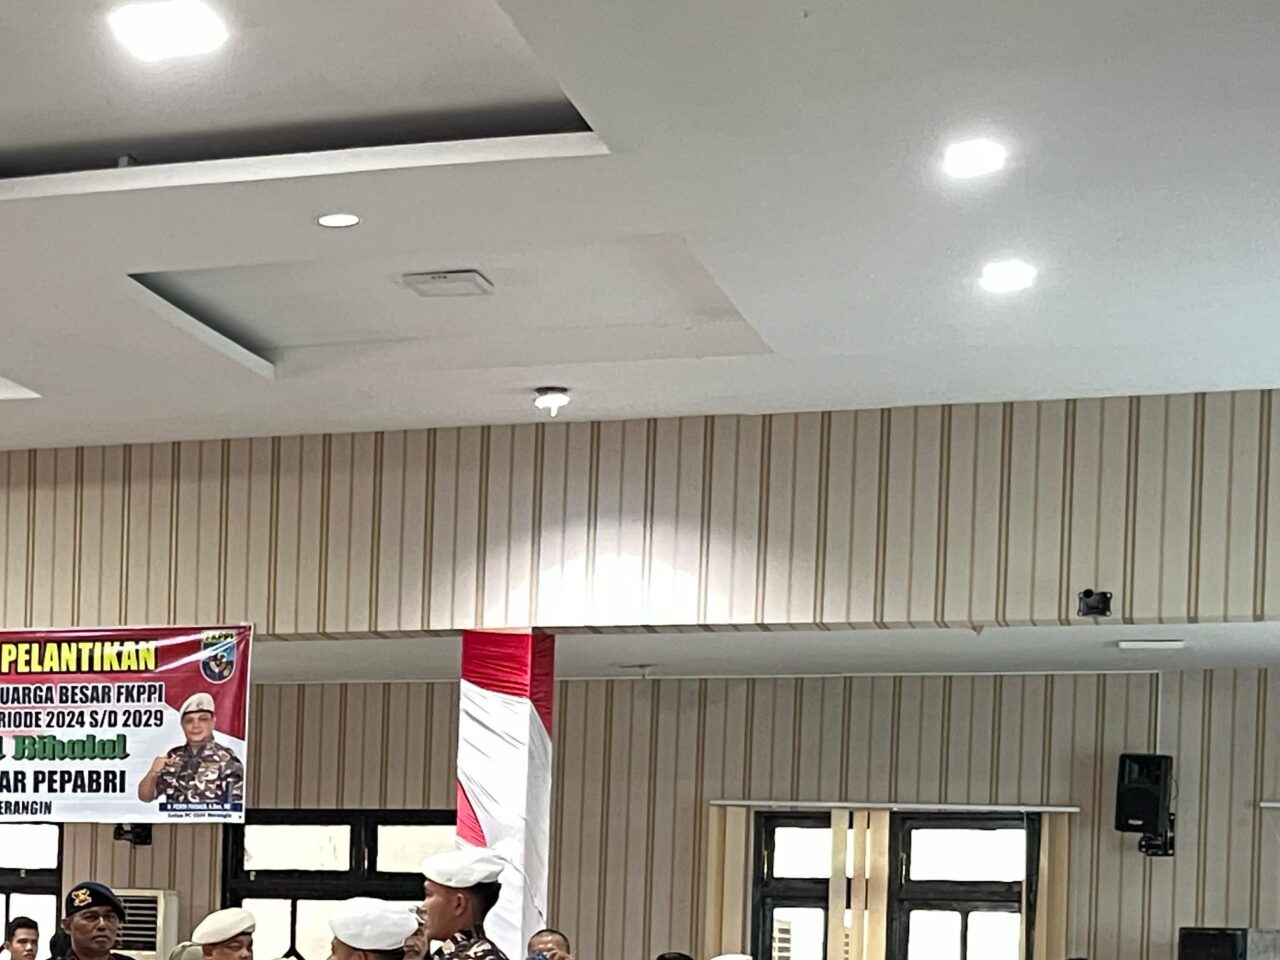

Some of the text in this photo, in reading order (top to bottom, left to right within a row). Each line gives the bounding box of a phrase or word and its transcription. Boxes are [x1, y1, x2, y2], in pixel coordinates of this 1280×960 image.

[0, 641, 157, 674] PELANTIKAN
[59, 684, 112, 704] BESAR
[116, 683, 163, 703] FKPPI
[46, 710, 86, 728] 2024
[89, 710, 118, 728] S/D
[122, 709, 164, 728] 2029
[12, 733, 130, 761] Bihalal
[33, 770, 127, 794] PEPABRI
